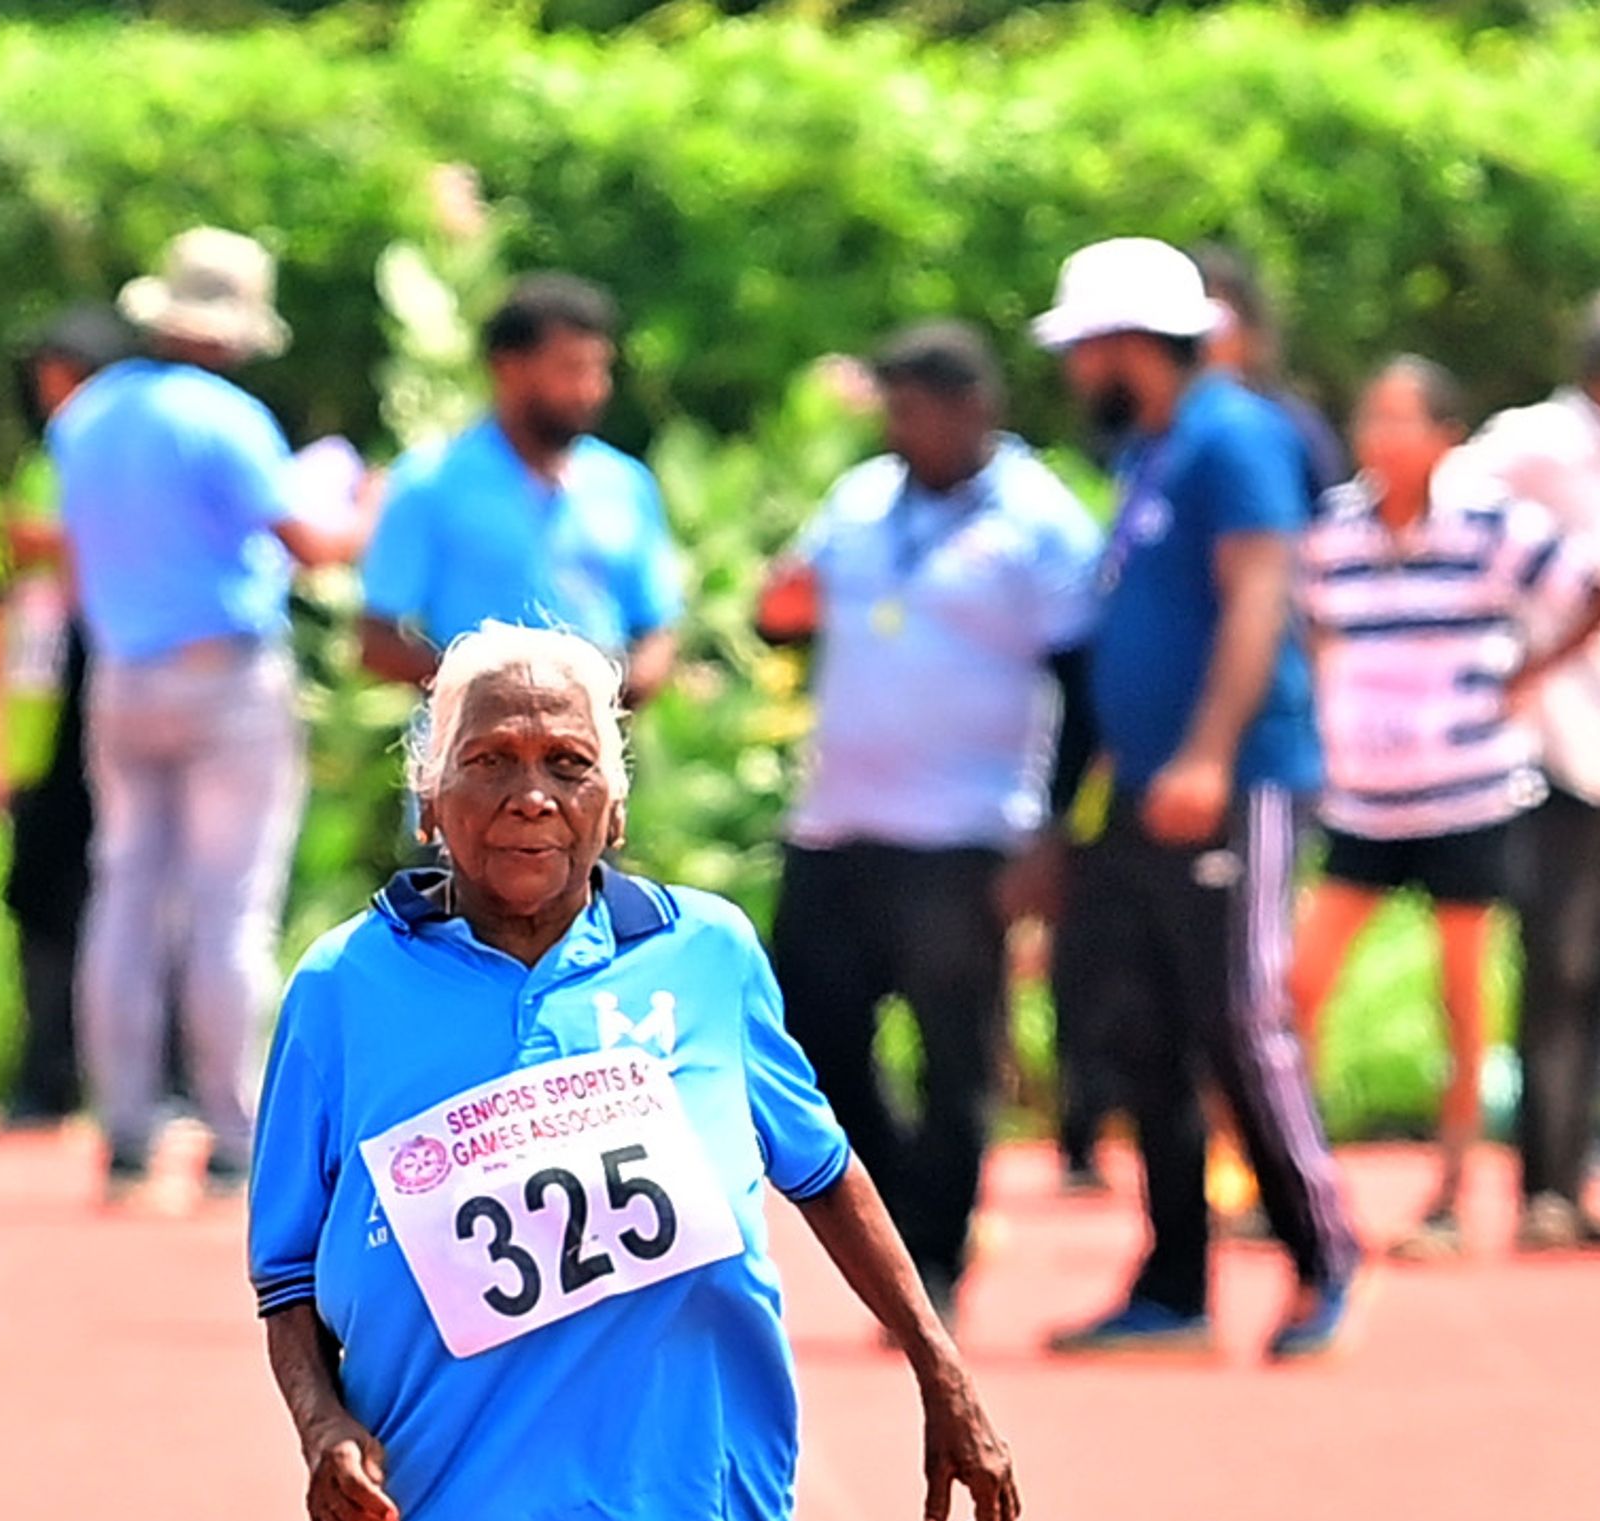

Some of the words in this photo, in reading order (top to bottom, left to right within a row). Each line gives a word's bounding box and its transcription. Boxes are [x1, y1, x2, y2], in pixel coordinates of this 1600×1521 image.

[542, 1066, 626, 1105] SPORTS
[452, 1124, 527, 1167] GAMES
[455, 1143, 678, 1318] 325
